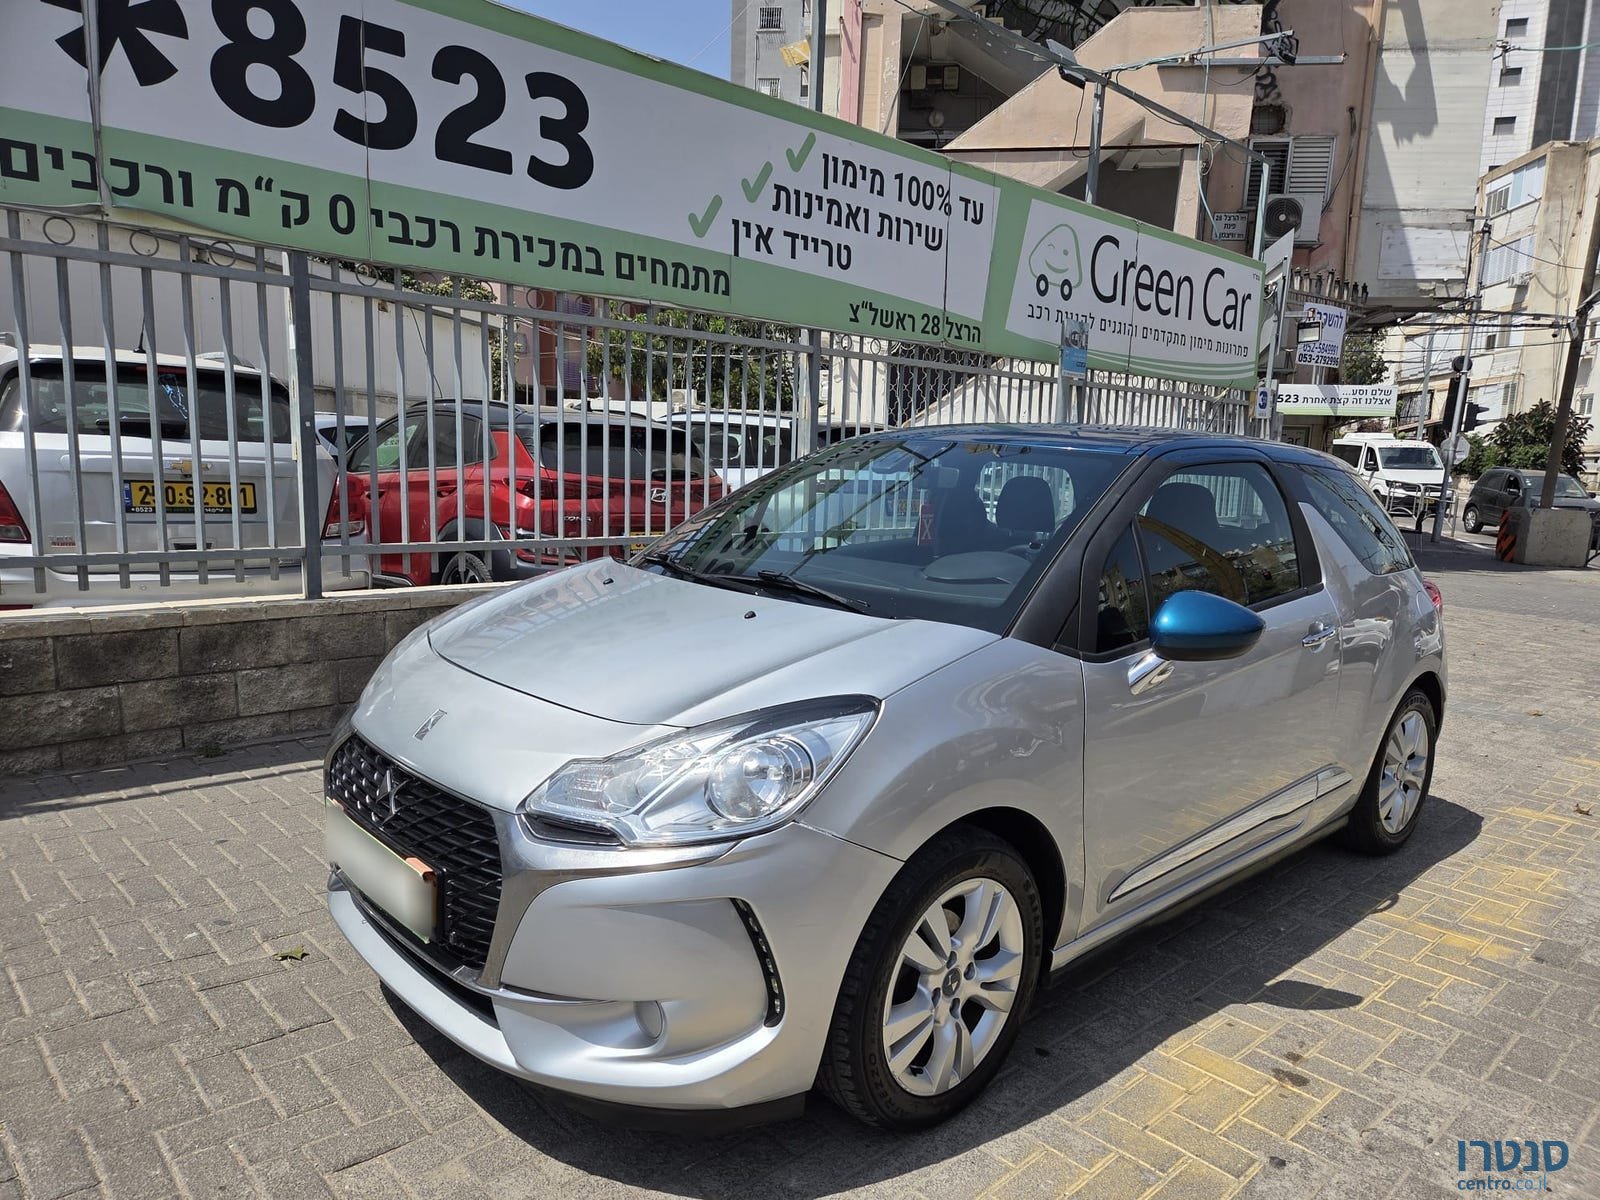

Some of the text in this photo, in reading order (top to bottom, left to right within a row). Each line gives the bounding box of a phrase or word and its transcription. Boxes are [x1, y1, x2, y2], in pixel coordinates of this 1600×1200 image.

[0, 137, 194, 208] ורכבים
[822, 153, 984, 225] עד 100% מימון
[328, 193, 356, 235] 0
[370, 207, 461, 253] רכבי
[772, 183, 944, 252] שירות ואמינות
[473, 225, 605, 277] במכירת
[731, 218, 852, 271] טרייד אין
[615, 251, 730, 297] מתמחים
[1090, 234, 1252, 332] Green Car
[920, 313, 941, 336] 28
[945, 316, 981, 344] הרצל
[1027, 303, 1051, 322] רכב
[1099, 318, 1138, 338] והוגנים
[1141, 326, 1186, 347] מתקדמים
[1189, 335, 1213, 352] מימון
[1215, 341, 1249, 358] פתרונות
[1301, 396, 1391, 406] אצלנו זה קצת אחרת
[1370, 388, 1393, 397] שלם
